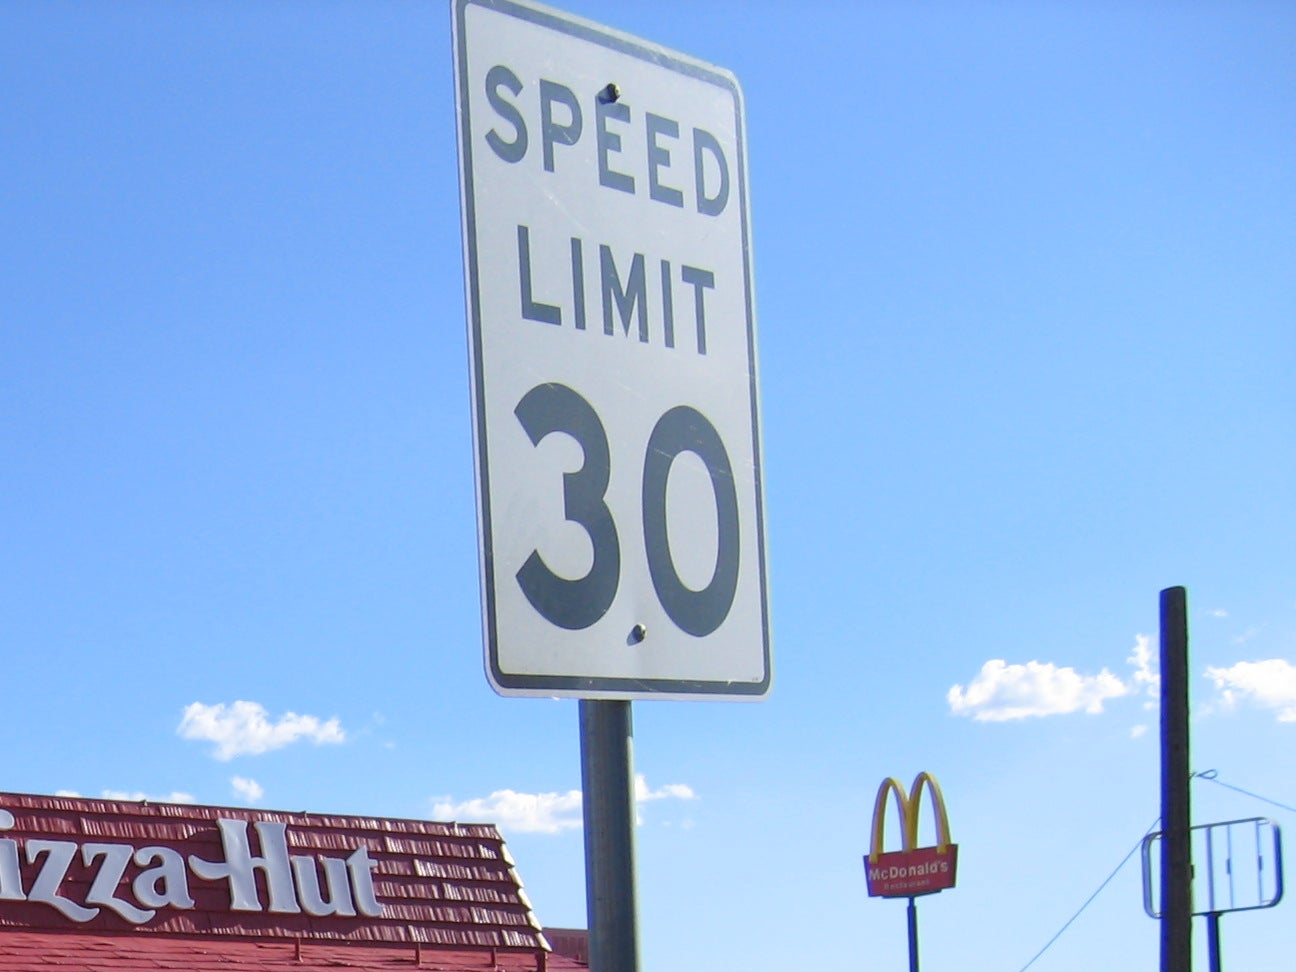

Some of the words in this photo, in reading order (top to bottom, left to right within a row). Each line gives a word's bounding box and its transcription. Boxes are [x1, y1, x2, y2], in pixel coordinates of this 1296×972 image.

[484, 64, 731, 217] SPEED
[517, 225, 716, 356] LIMIT
[514, 381, 741, 638] 30
[188, 817, 385, 918] Hut
[869, 860, 949, 881] McDonald's
